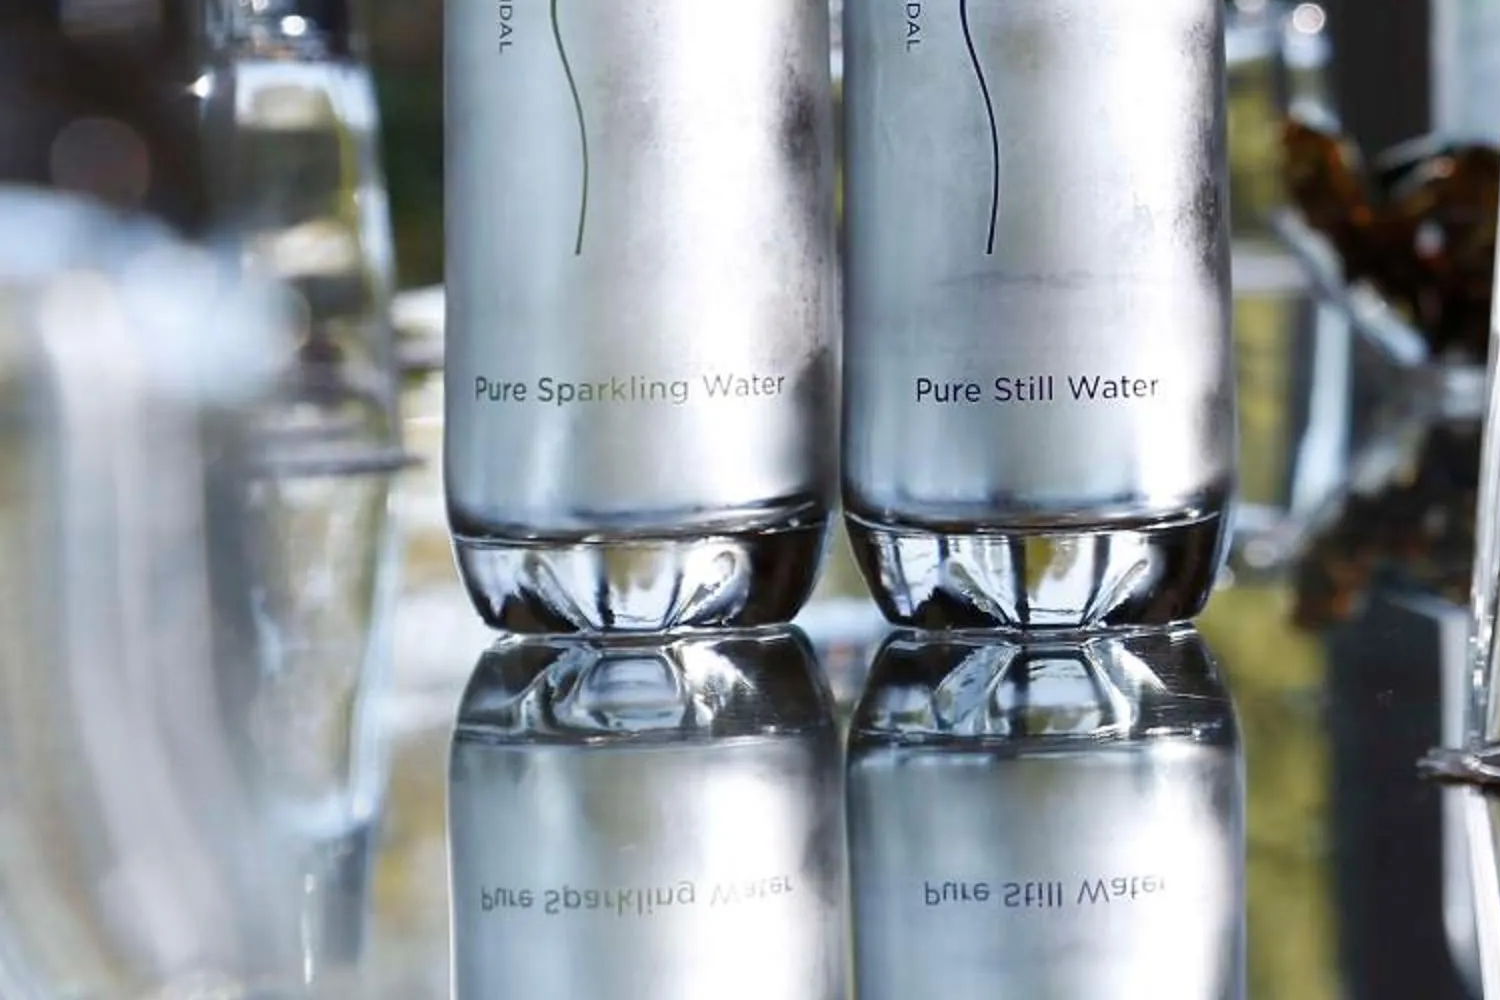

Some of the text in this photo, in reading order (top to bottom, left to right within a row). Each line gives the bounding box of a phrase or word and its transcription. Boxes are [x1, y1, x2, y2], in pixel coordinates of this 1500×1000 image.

[475, 373, 786, 406] Pure Sparkling Water
[916, 375, 1159, 403] Pure Still Water
